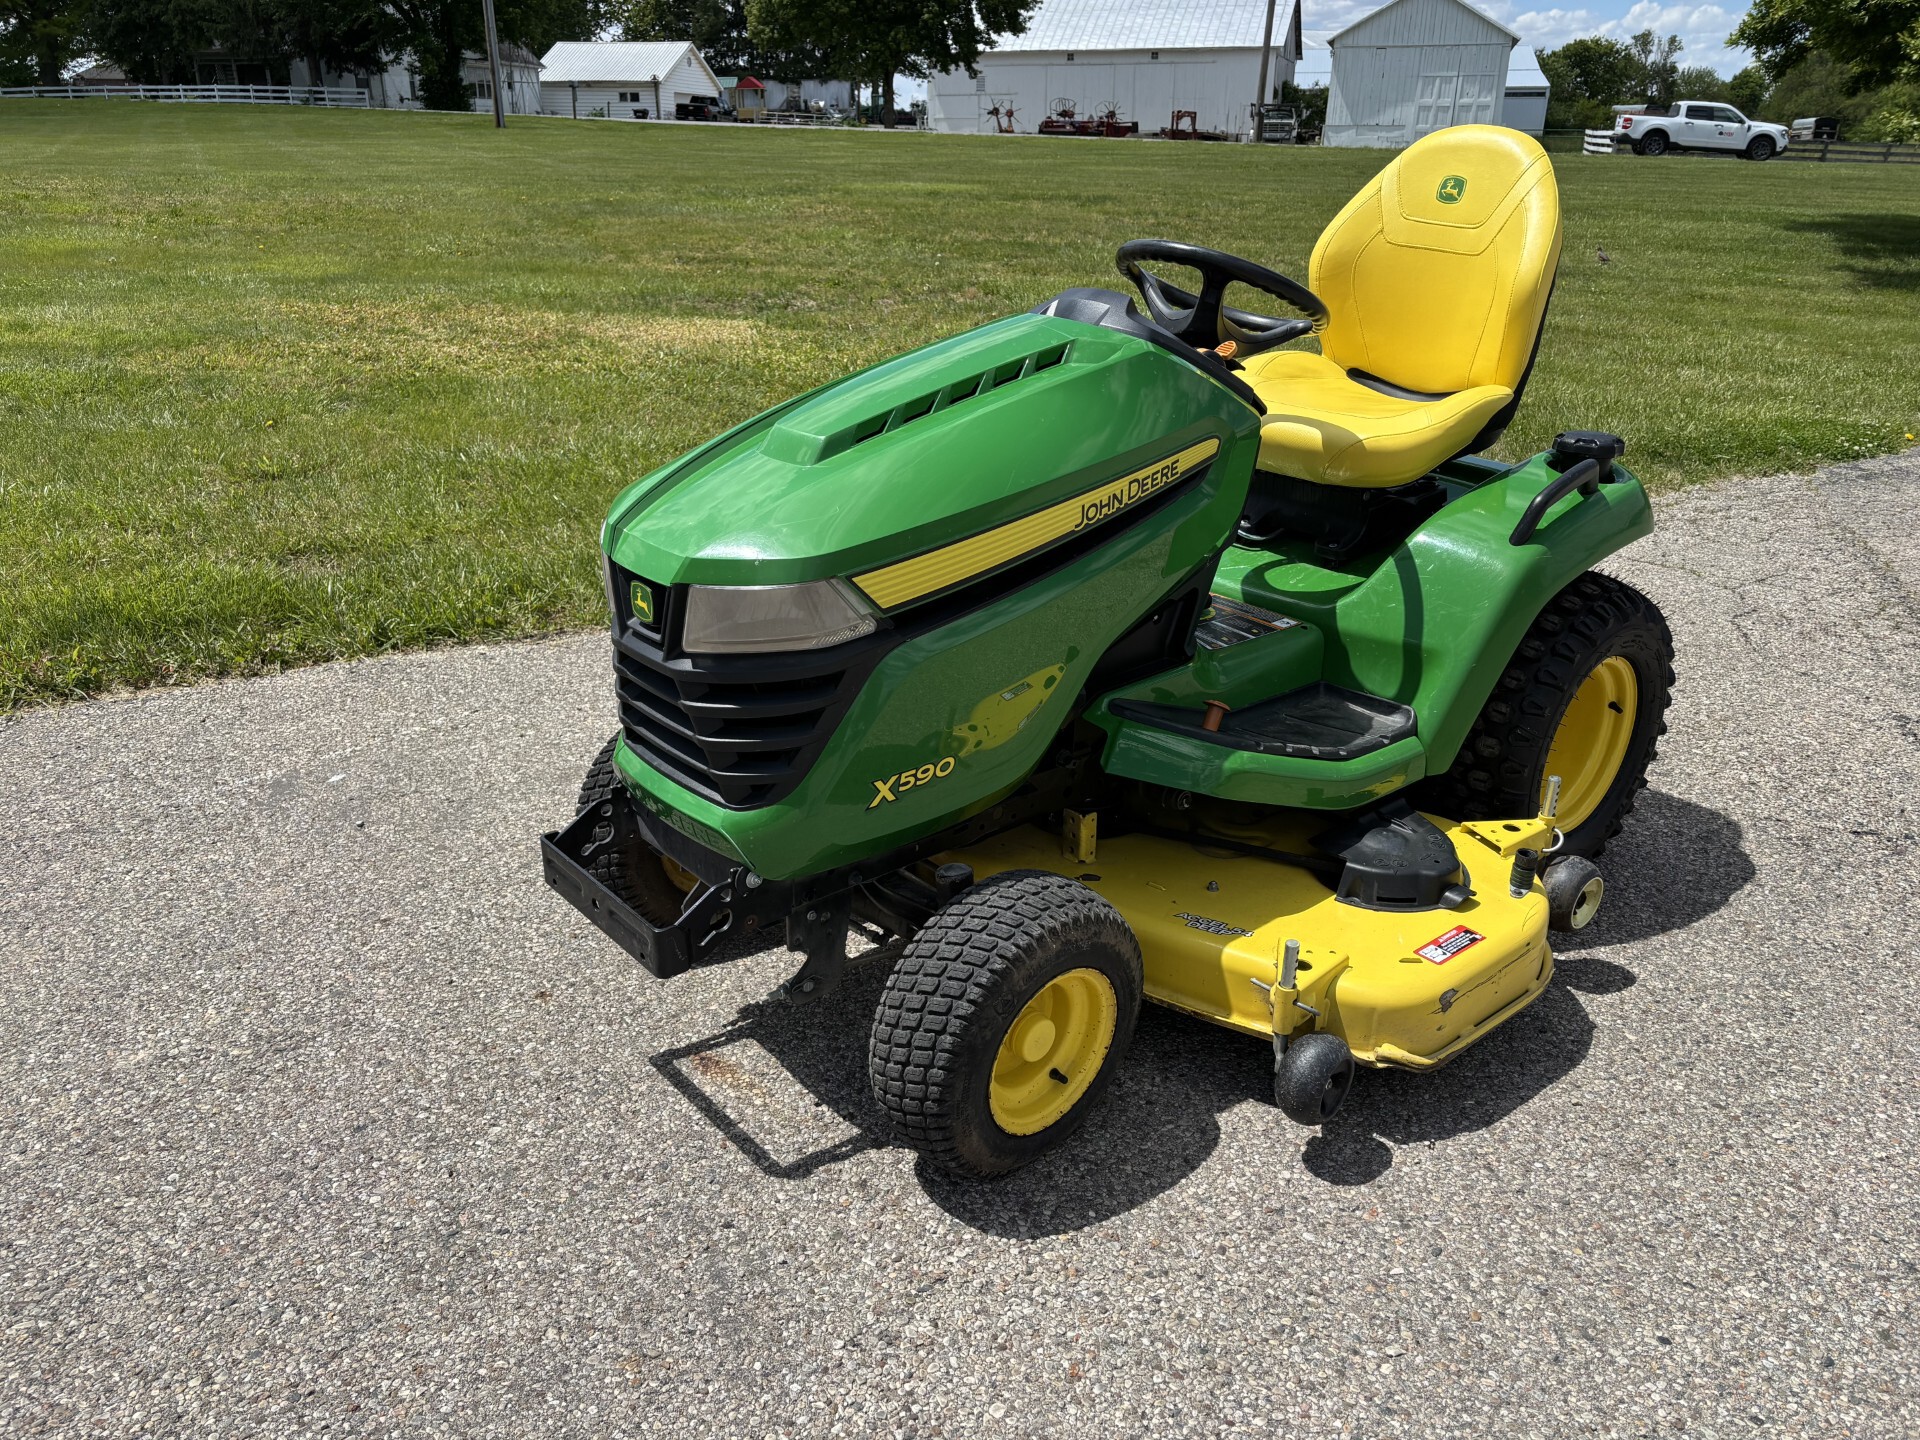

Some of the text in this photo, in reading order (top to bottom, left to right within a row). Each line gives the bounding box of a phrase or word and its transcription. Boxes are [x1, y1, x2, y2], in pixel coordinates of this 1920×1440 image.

[1074, 459, 1180, 530] JOHN DEERE
[866, 756, 955, 810] X590
[1173, 912, 1228, 929] ACCEL
[1185, 921, 1233, 935] DEEP
